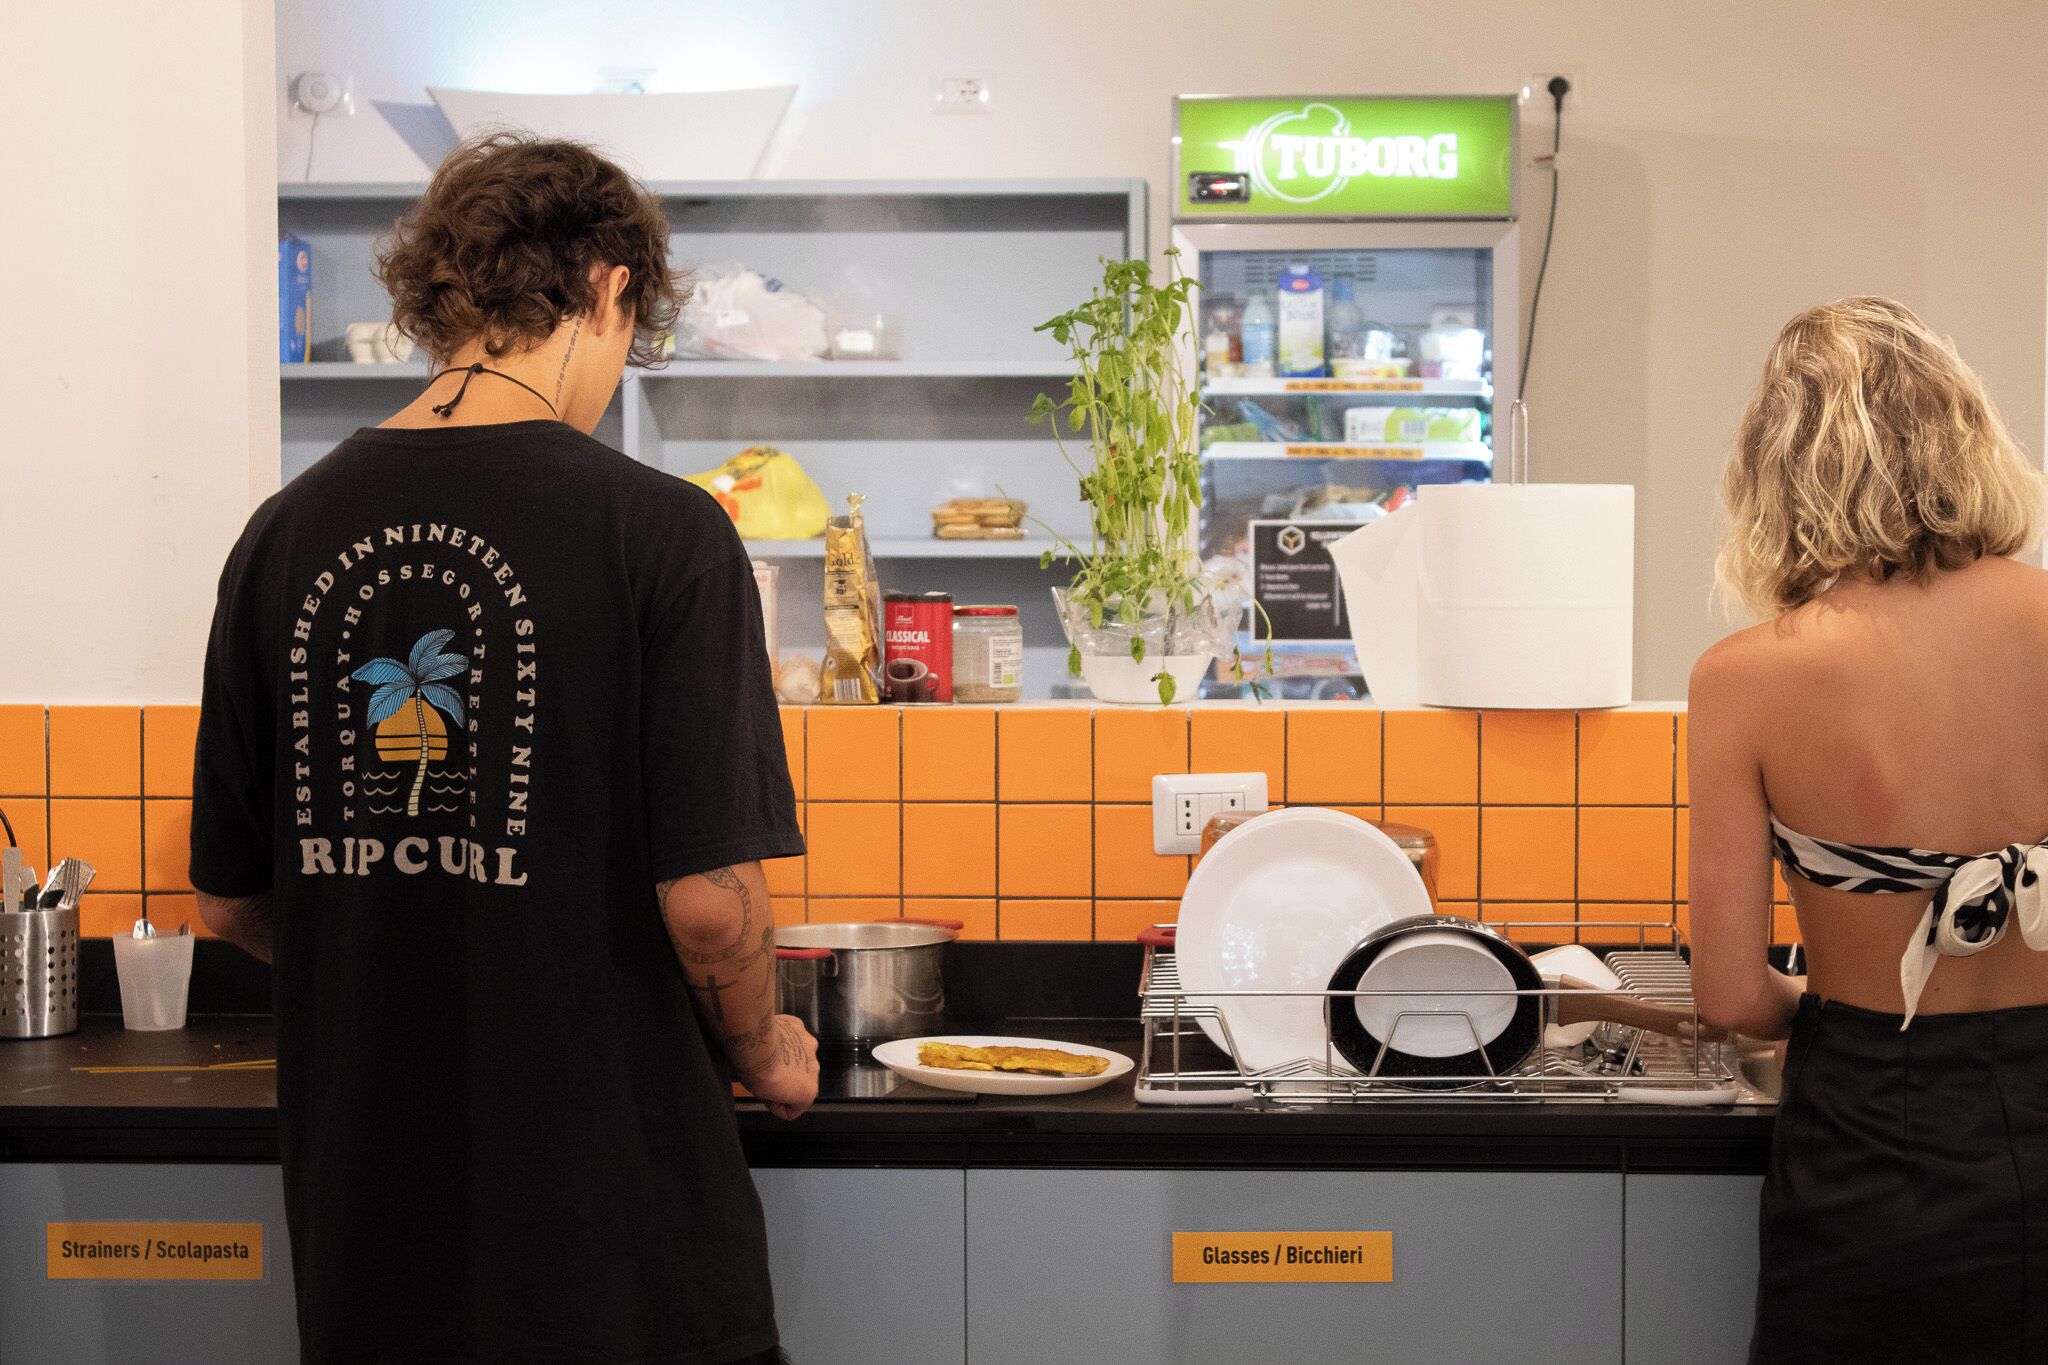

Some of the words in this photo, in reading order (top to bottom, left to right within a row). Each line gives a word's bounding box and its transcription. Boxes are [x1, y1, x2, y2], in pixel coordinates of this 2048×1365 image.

[1270, 133, 1459, 180] TUBORG
[337, 536, 375, 570] IN
[383, 523, 527, 608] NINETEEN
[344, 564, 483, 626] HOSSEGOR
[886, 630, 931, 643] CLASSICAL
[290, 570, 335, 826] ESTABLISHED
[514, 618, 536, 735] SIXTY
[337, 649, 355, 821] TORQUAY
[506, 745, 532, 837] NINE
[299, 836, 385, 877] RIP
[393, 836, 528, 887] CURL
[62, 1240, 141, 1259] Strainers
[144, 1239, 152, 1260] /
[156, 1240, 249, 1263] Scolapasta
[1202, 1246, 1270, 1265] Glasses
[1274, 1244, 1282, 1266] /
[1287, 1246, 1363, 1264] Bicchieri
